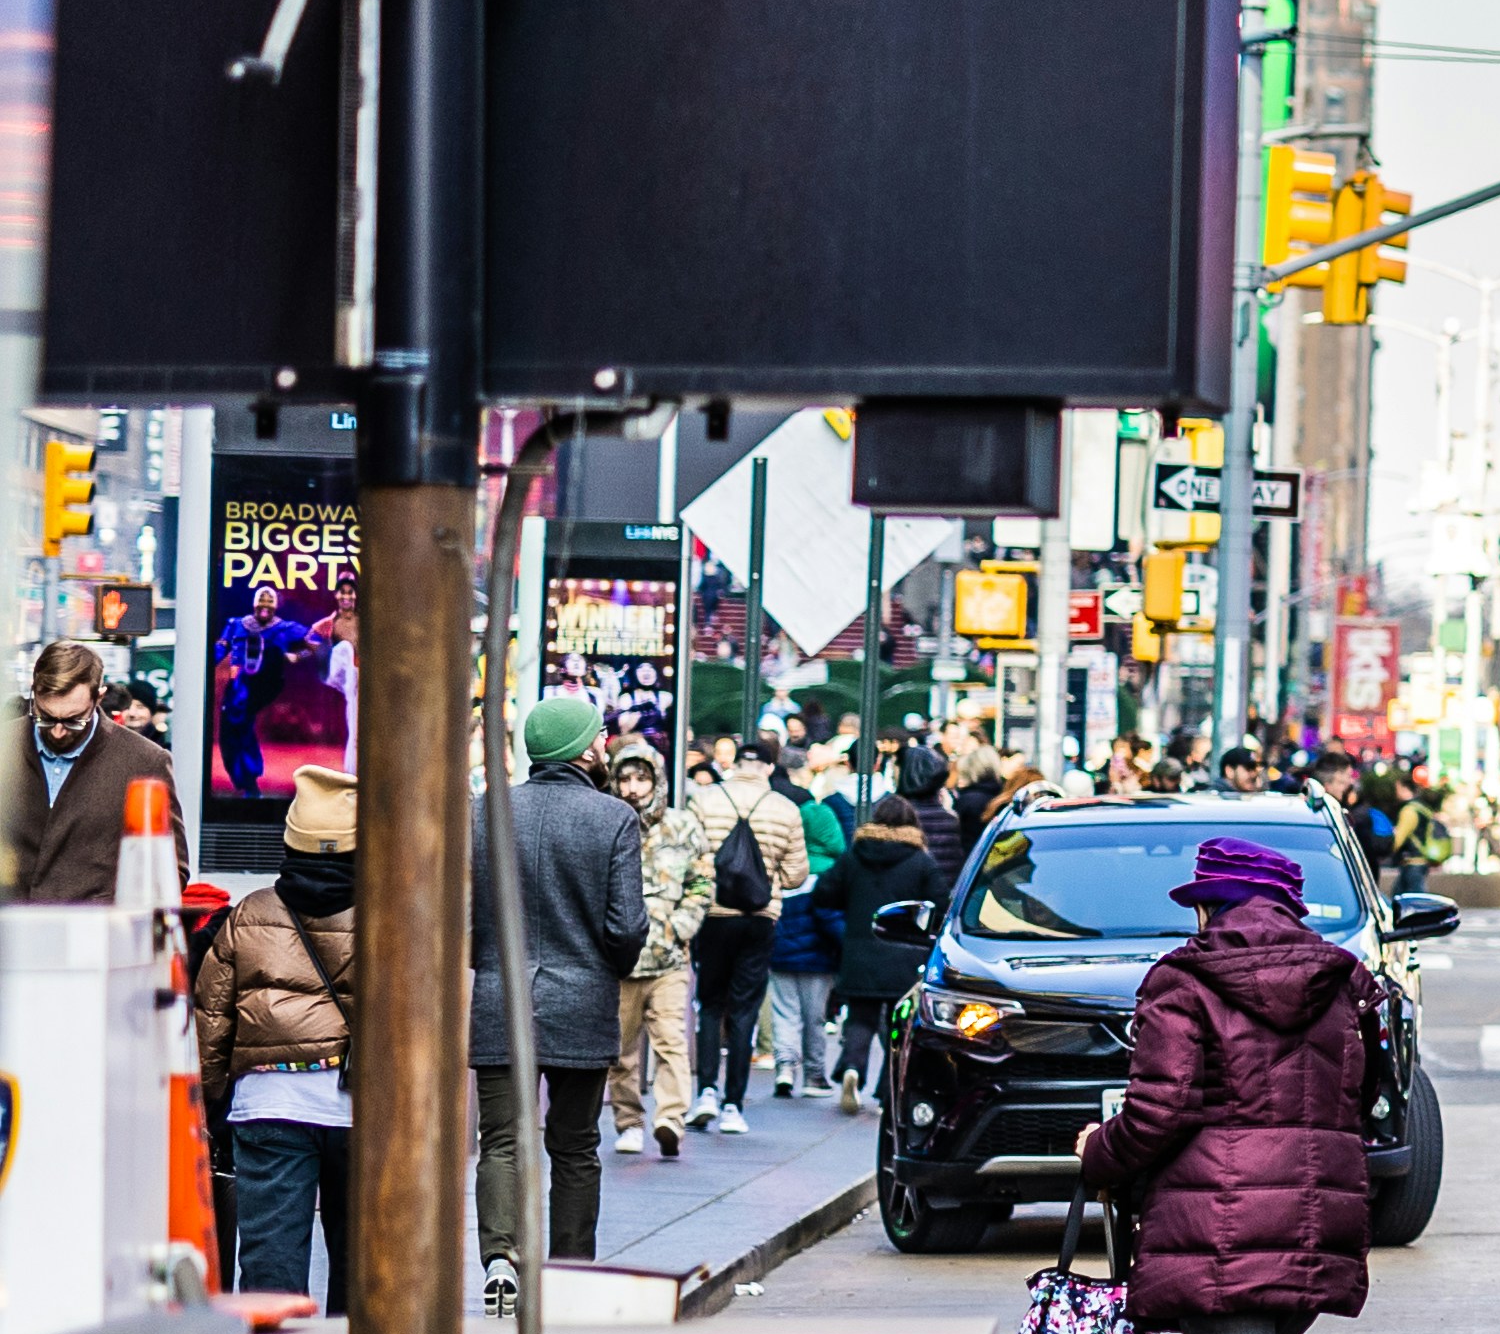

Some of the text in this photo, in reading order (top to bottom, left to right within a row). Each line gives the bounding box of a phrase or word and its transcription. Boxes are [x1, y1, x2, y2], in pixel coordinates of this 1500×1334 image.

[331, 412, 358, 430] Lin
[1177, 479, 1284, 505] ONE AY
[225, 500, 362, 522] BROADWA
[223, 521, 362, 554] BIGGES
